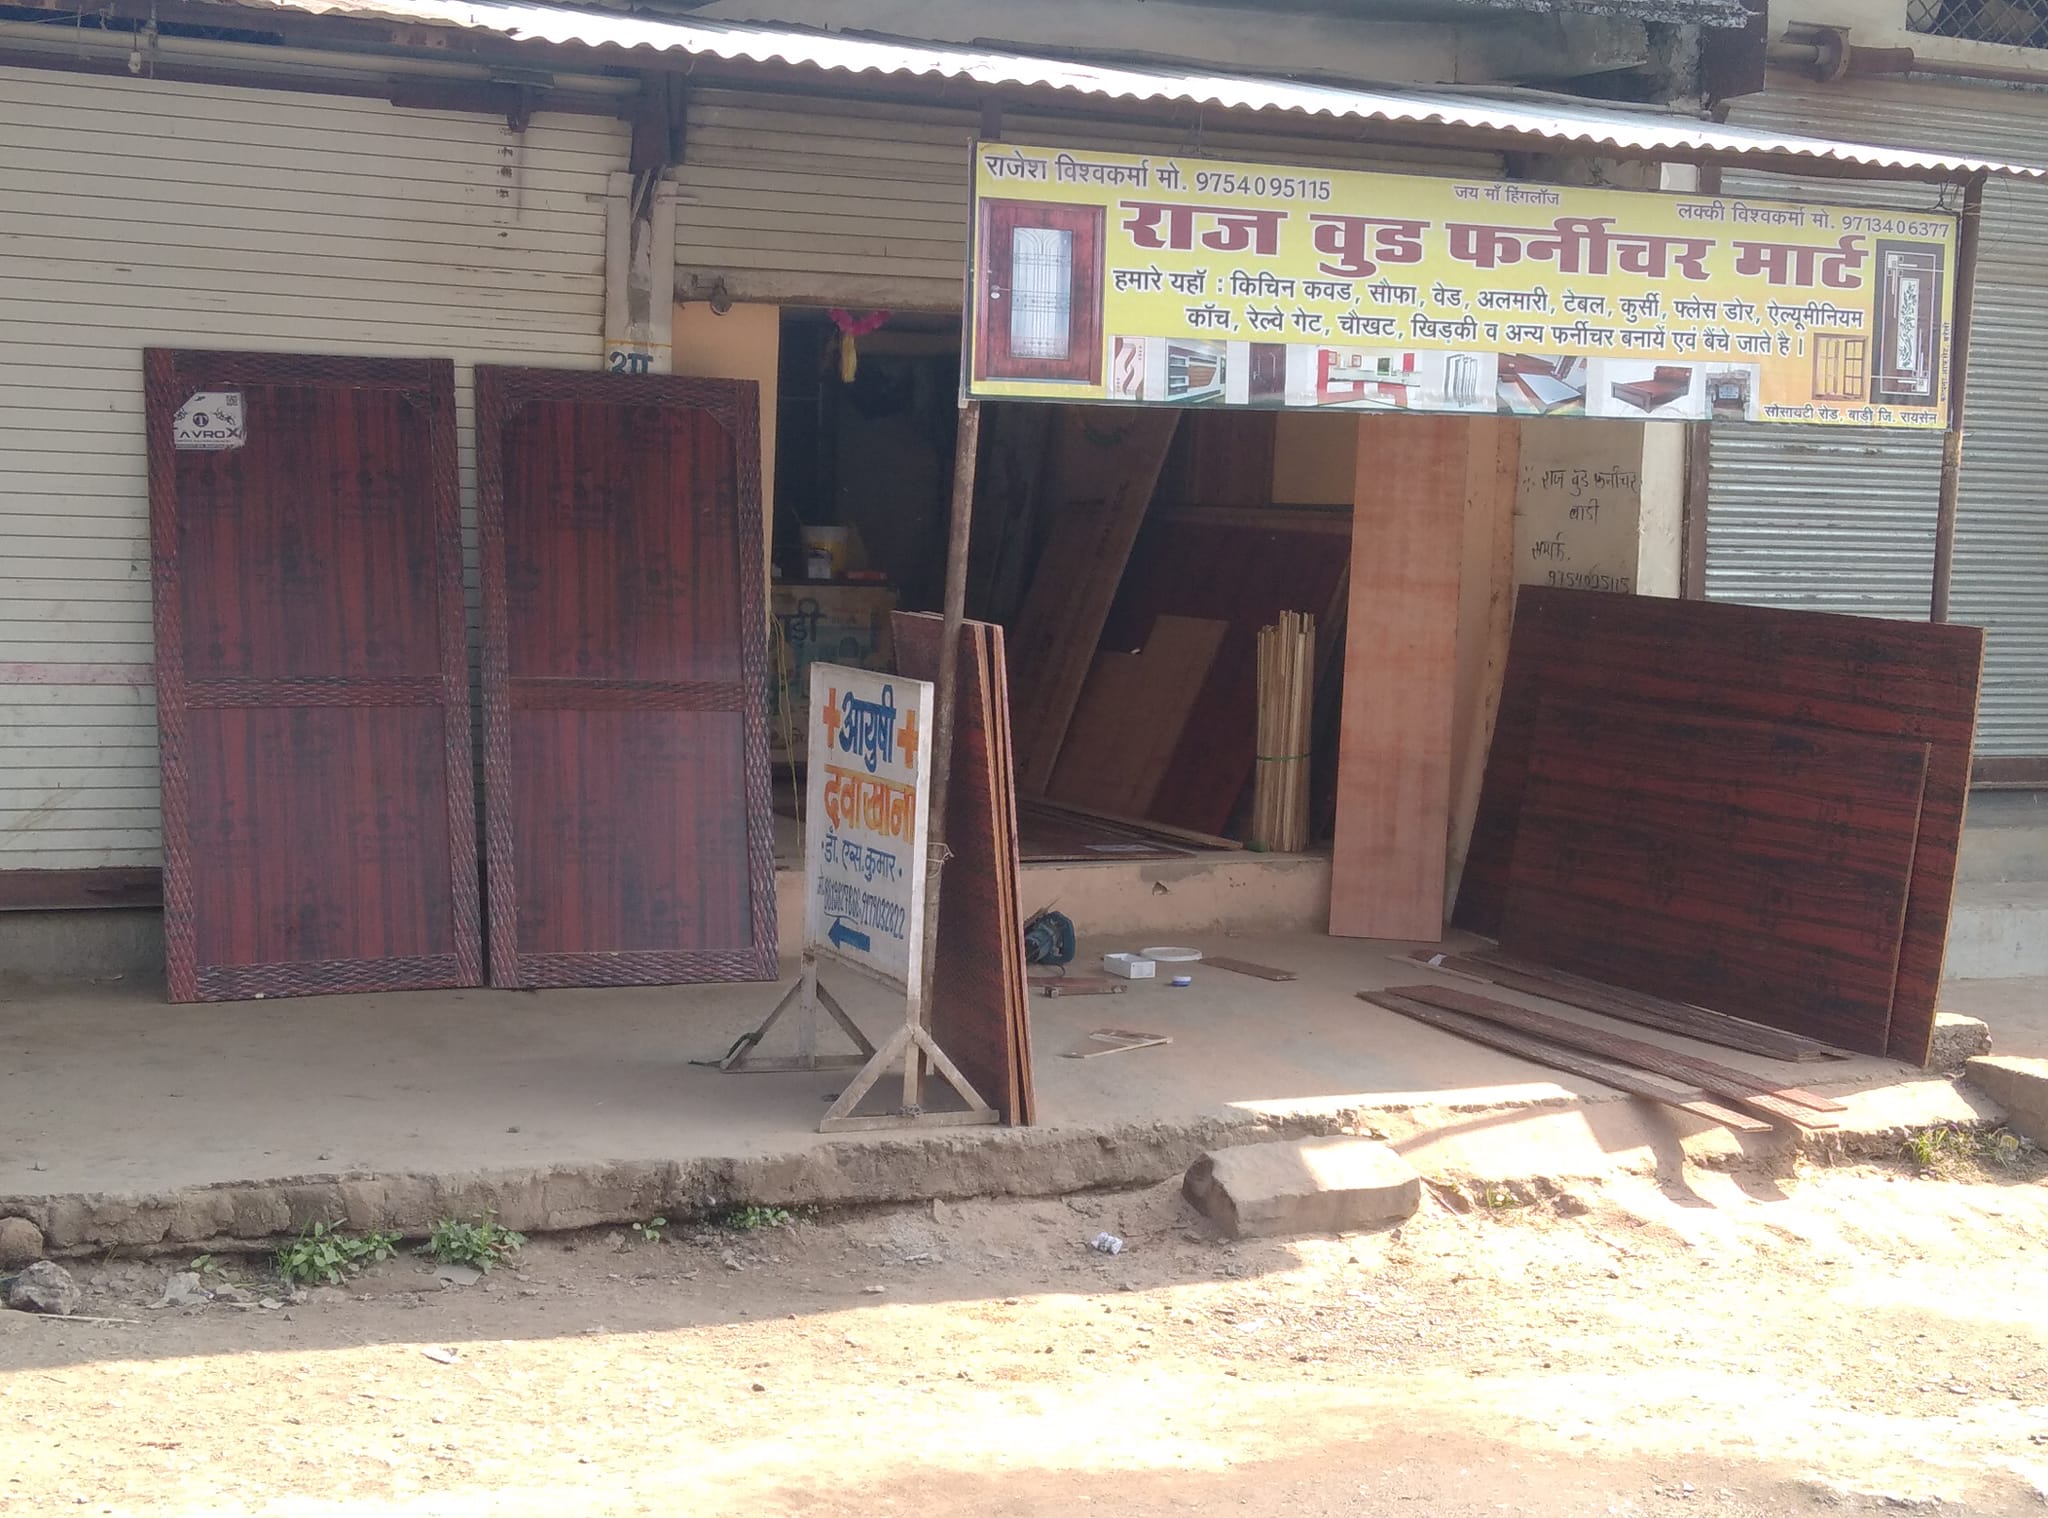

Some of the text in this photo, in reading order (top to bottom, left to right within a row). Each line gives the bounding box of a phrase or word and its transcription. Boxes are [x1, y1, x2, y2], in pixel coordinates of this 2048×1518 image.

[985, 150, 1331, 201] राजेश विश्वकर्मा मो. 9754095115
[1454, 185, 1479, 200] जय
[1484, 183, 1501, 201] माँ
[1119, 199, 1870, 289] राज वुड फर्नीचर मार्ट
[1676, 200, 1950, 239] लक्की विश्वकर्मा मो. 9713406377
[1112, 264, 1164, 291] हमारे
[1230, 269, 1296, 298] किचिन
[1302, 279, 1361, 304] कवड,
[1477, 285, 1556, 315] अलमारी,
[1561, 288, 1612, 318] टेबल,
[1619, 292, 1667, 323] कुर्सी,
[1672, 294, 1717, 320] फ्लेस
[1722, 297, 1761, 325] डोर,
[1766, 300, 1864, 331] ऐल्यूमीनियम
[1246, 304, 1285, 332] रेल्वे
[1291, 308, 1330, 336] गेट,
[1337, 311, 1404, 339] चौखट,
[1410, 312, 1478, 344] खिड़की
[1485, 323, 1499, 342] व
[1505, 323, 1545, 344] अन्य
[1550, 319, 1615, 347] फर्नीचर
[1620, 324, 1666, 349] बनायें
[1671, 328, 1697, 353] एवं
[1735, 329, 1772, 353] जाते
[1777, 330, 1792, 356] है
[1899, 409, 1938, 425] रायसेन
[838, 684, 897, 773] आयुषी
[823, 763, 916, 845] दवाखाना
[865, 847, 897, 882] कुमार
